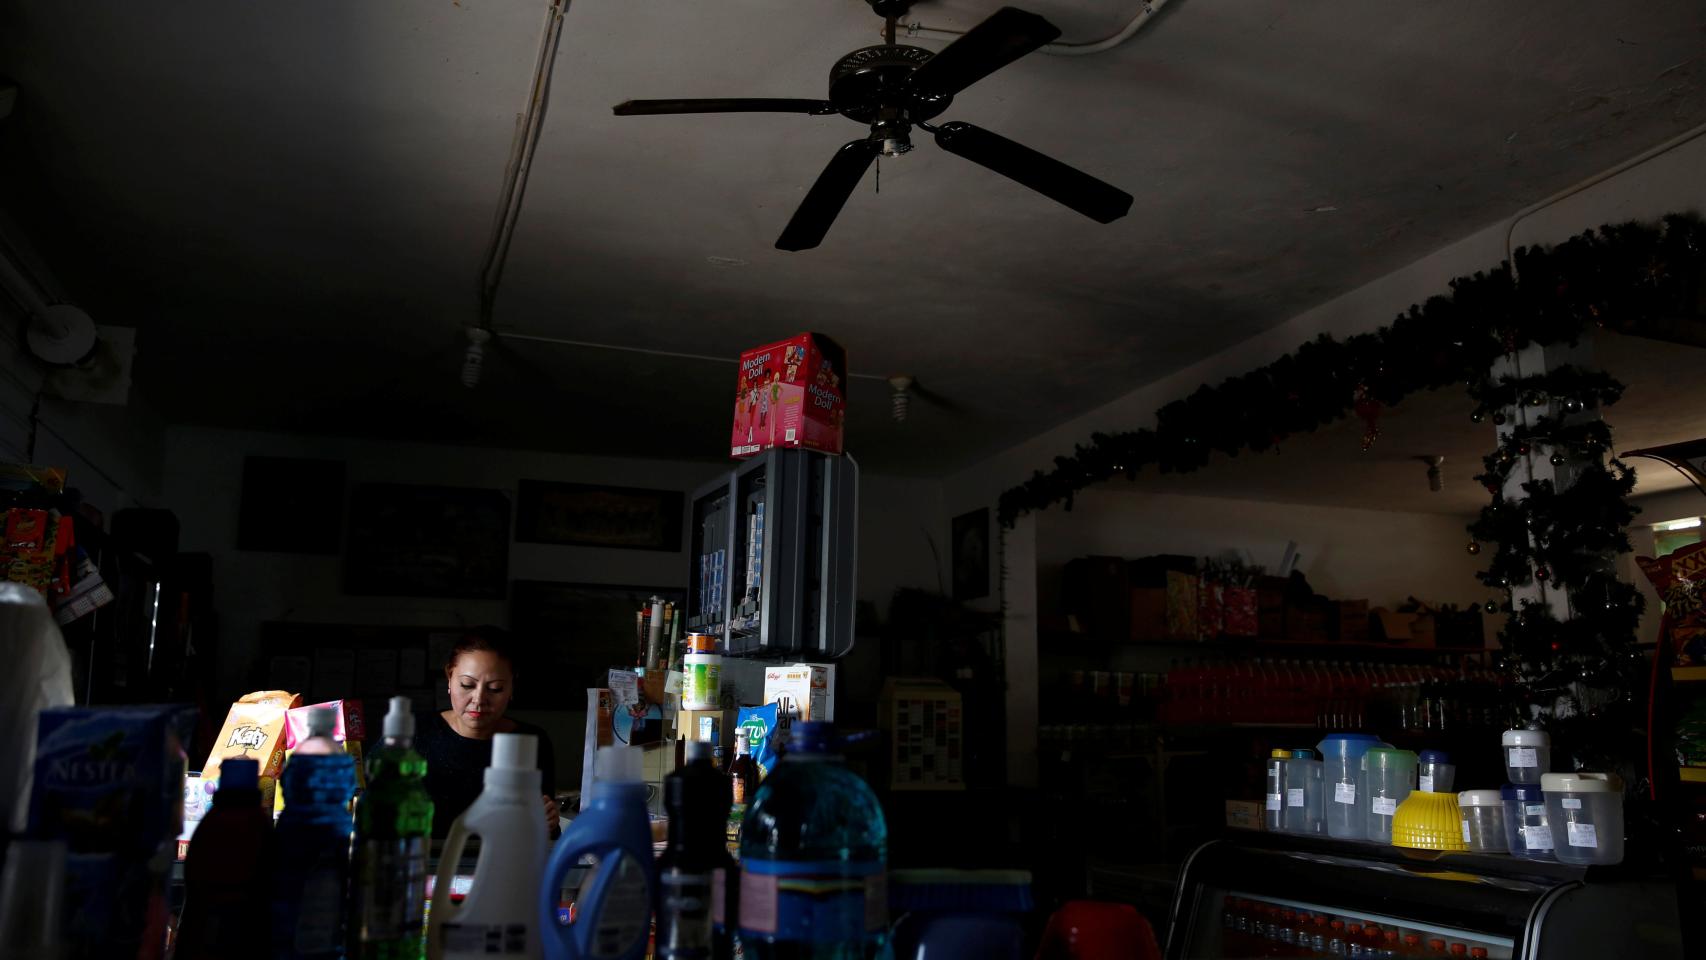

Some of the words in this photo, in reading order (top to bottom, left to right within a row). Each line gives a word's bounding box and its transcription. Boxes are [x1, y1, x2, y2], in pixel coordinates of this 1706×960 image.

[743, 352, 771, 371] Modern
[748, 365, 763, 379] Doll
[808, 383, 841, 404] Modern
[814, 396, 832, 410] Doll
[226, 726, 268, 750] Katy
